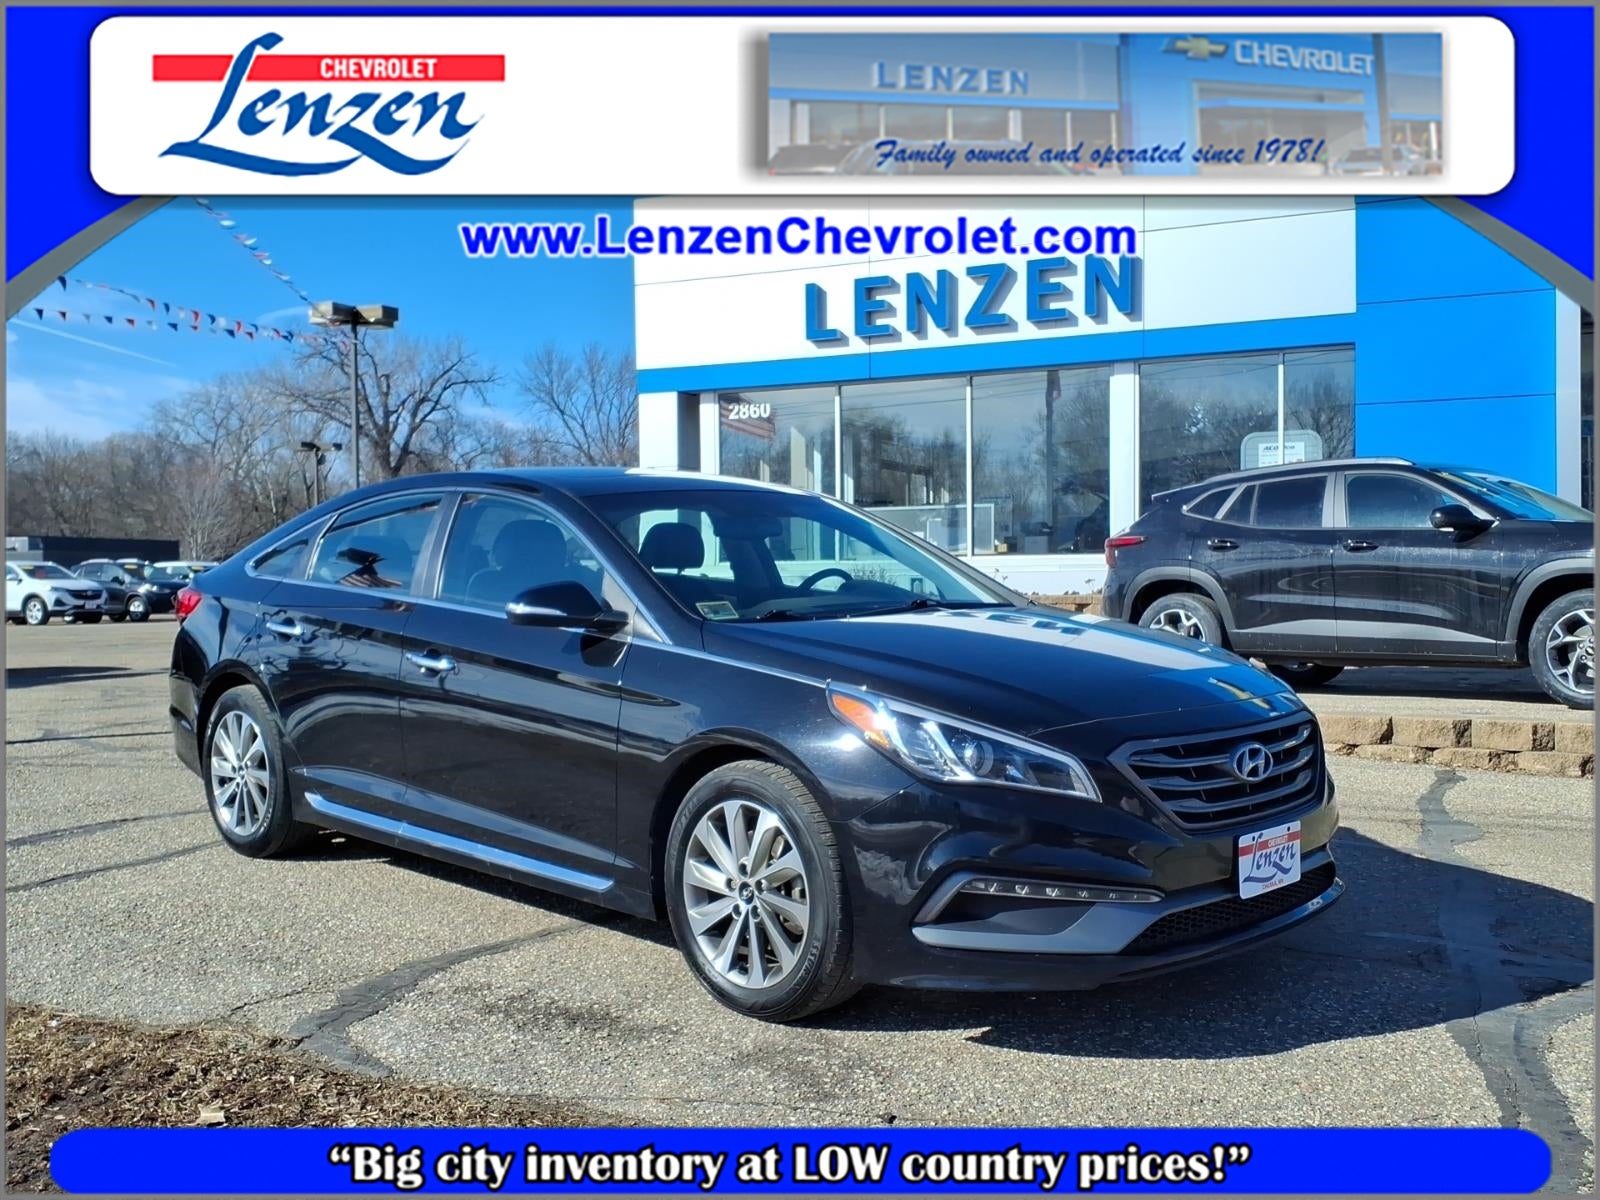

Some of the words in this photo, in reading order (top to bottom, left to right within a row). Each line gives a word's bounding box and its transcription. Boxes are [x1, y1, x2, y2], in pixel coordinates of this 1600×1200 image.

[805, 254, 1142, 348] LENZEN
[728, 403, 771, 420] 2860
[1242, 832, 1296, 884] Lenzen
